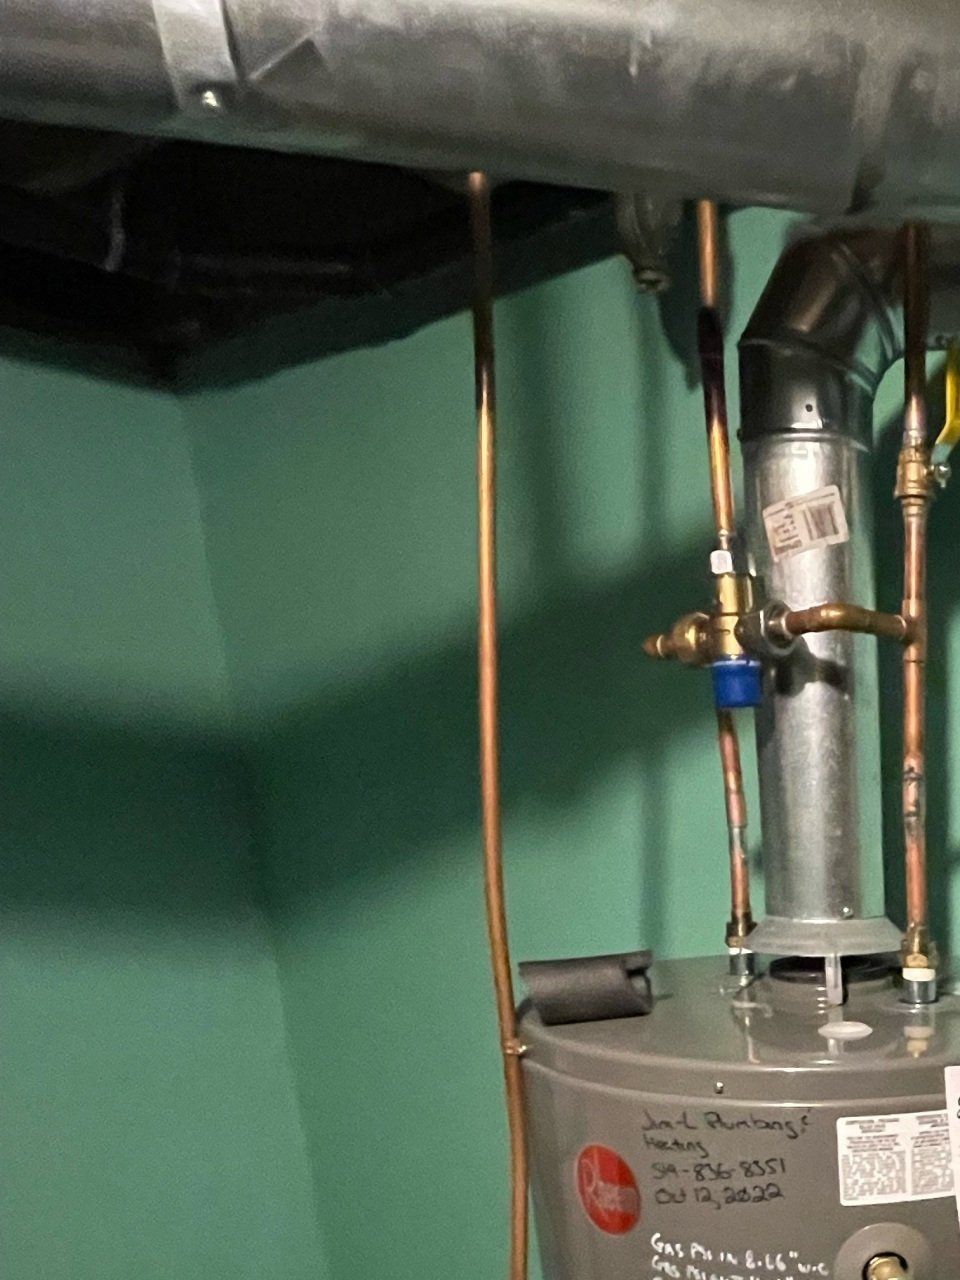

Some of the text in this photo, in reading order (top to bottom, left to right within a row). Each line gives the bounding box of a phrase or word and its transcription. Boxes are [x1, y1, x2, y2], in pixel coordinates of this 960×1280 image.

[643, 1133, 709, 1158] Heating
[651, 1157, 786, 1182] 519-836-8351
[723, 1183, 784, 1204] 2022
